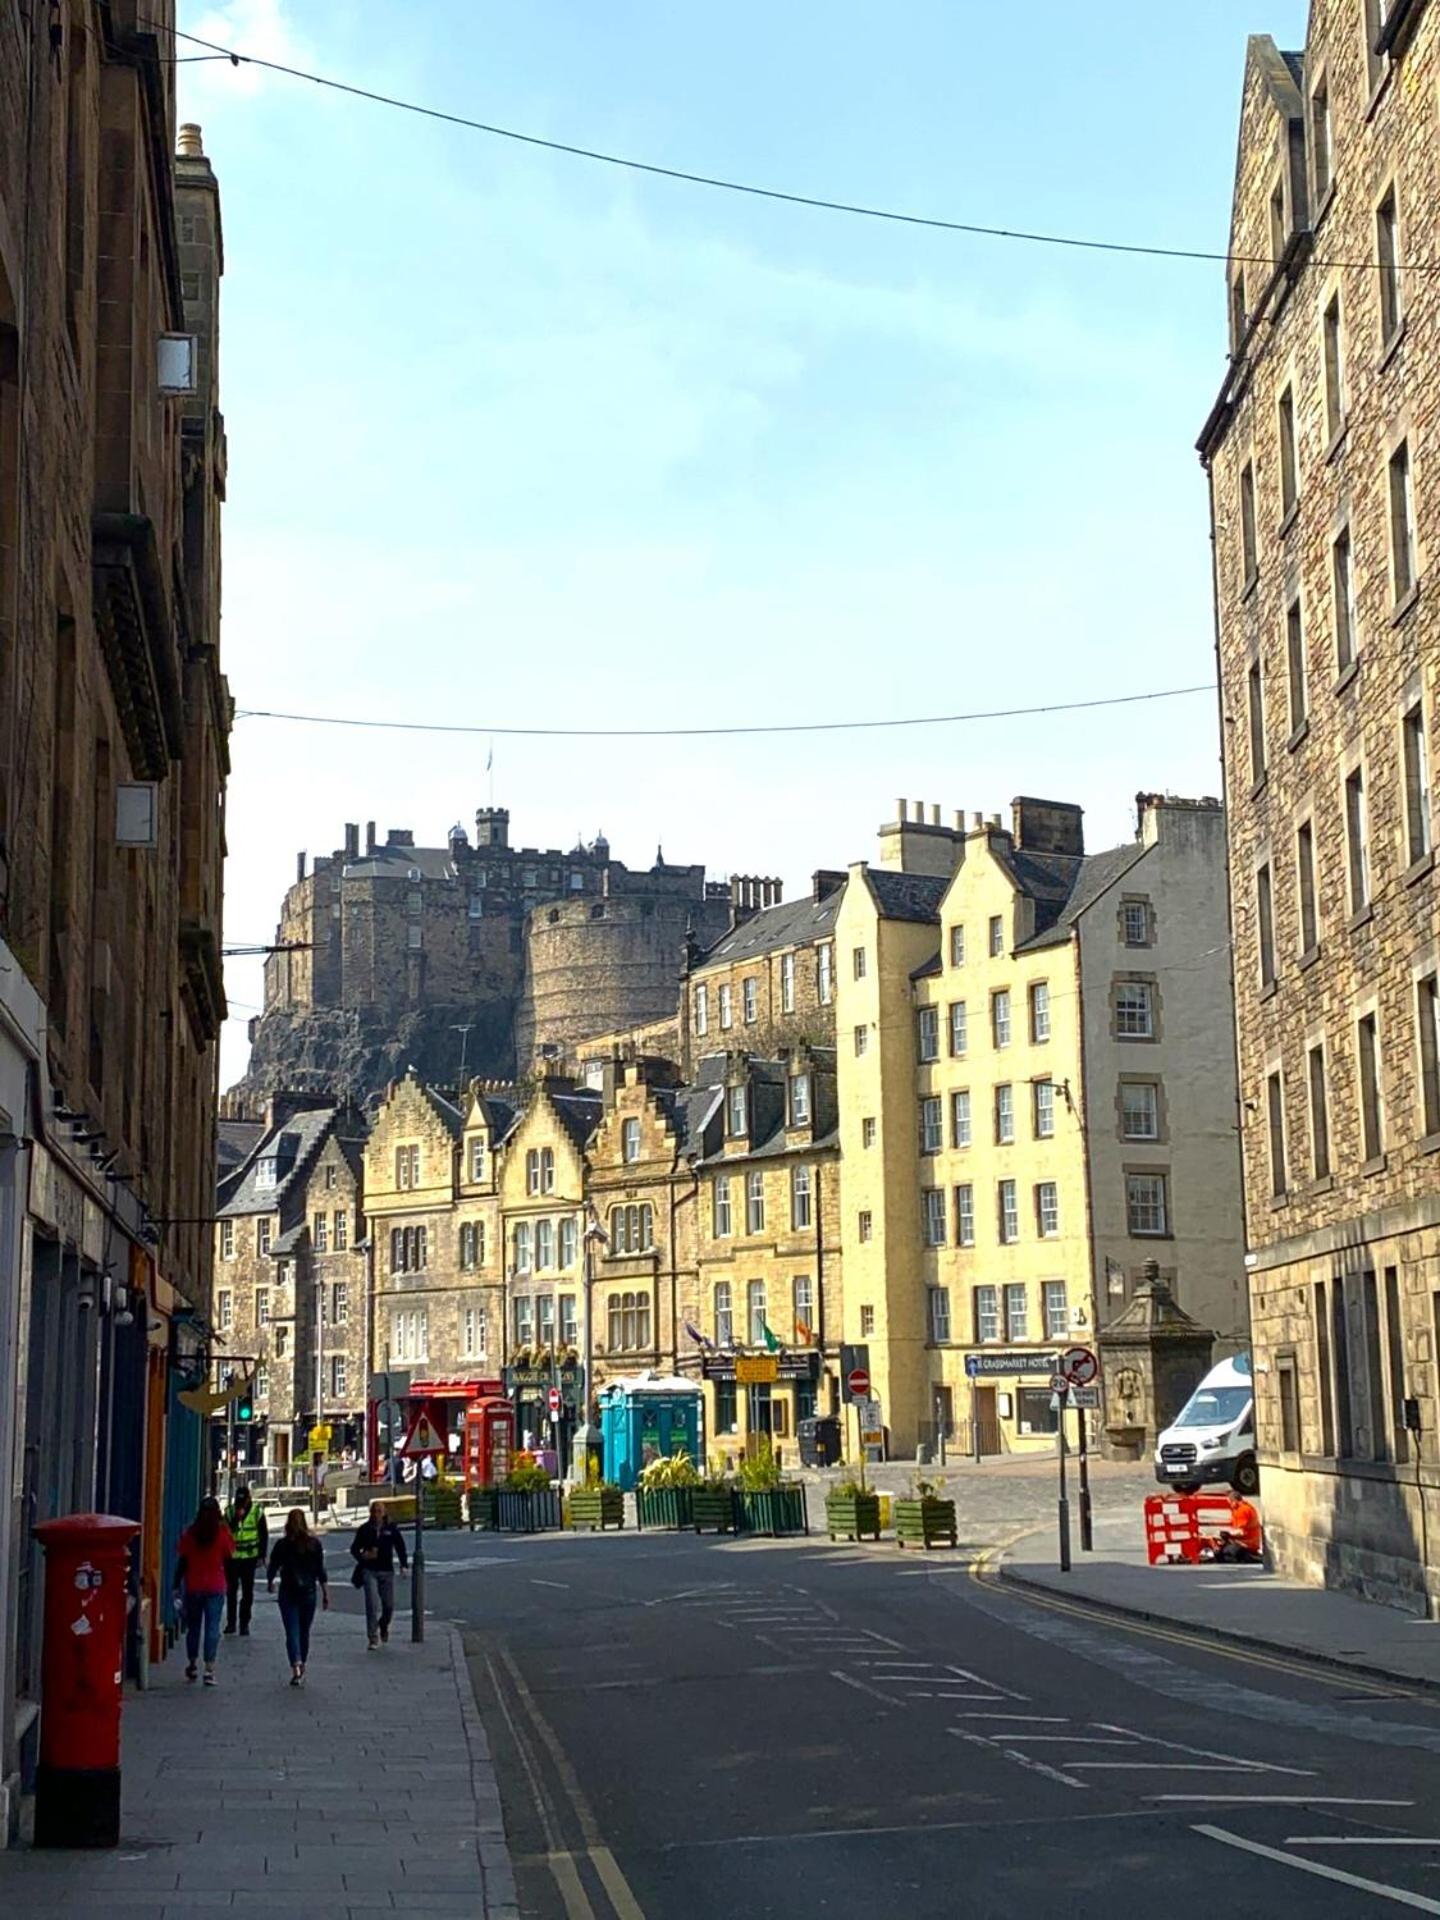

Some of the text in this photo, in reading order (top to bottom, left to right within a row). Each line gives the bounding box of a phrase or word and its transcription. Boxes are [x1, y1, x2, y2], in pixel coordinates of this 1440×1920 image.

[982, 1359, 1027, 1369] GRASSMARKET
[1028, 1358, 1050, 1368] HOTEL
[1055, 1379, 1065, 1387] 20
